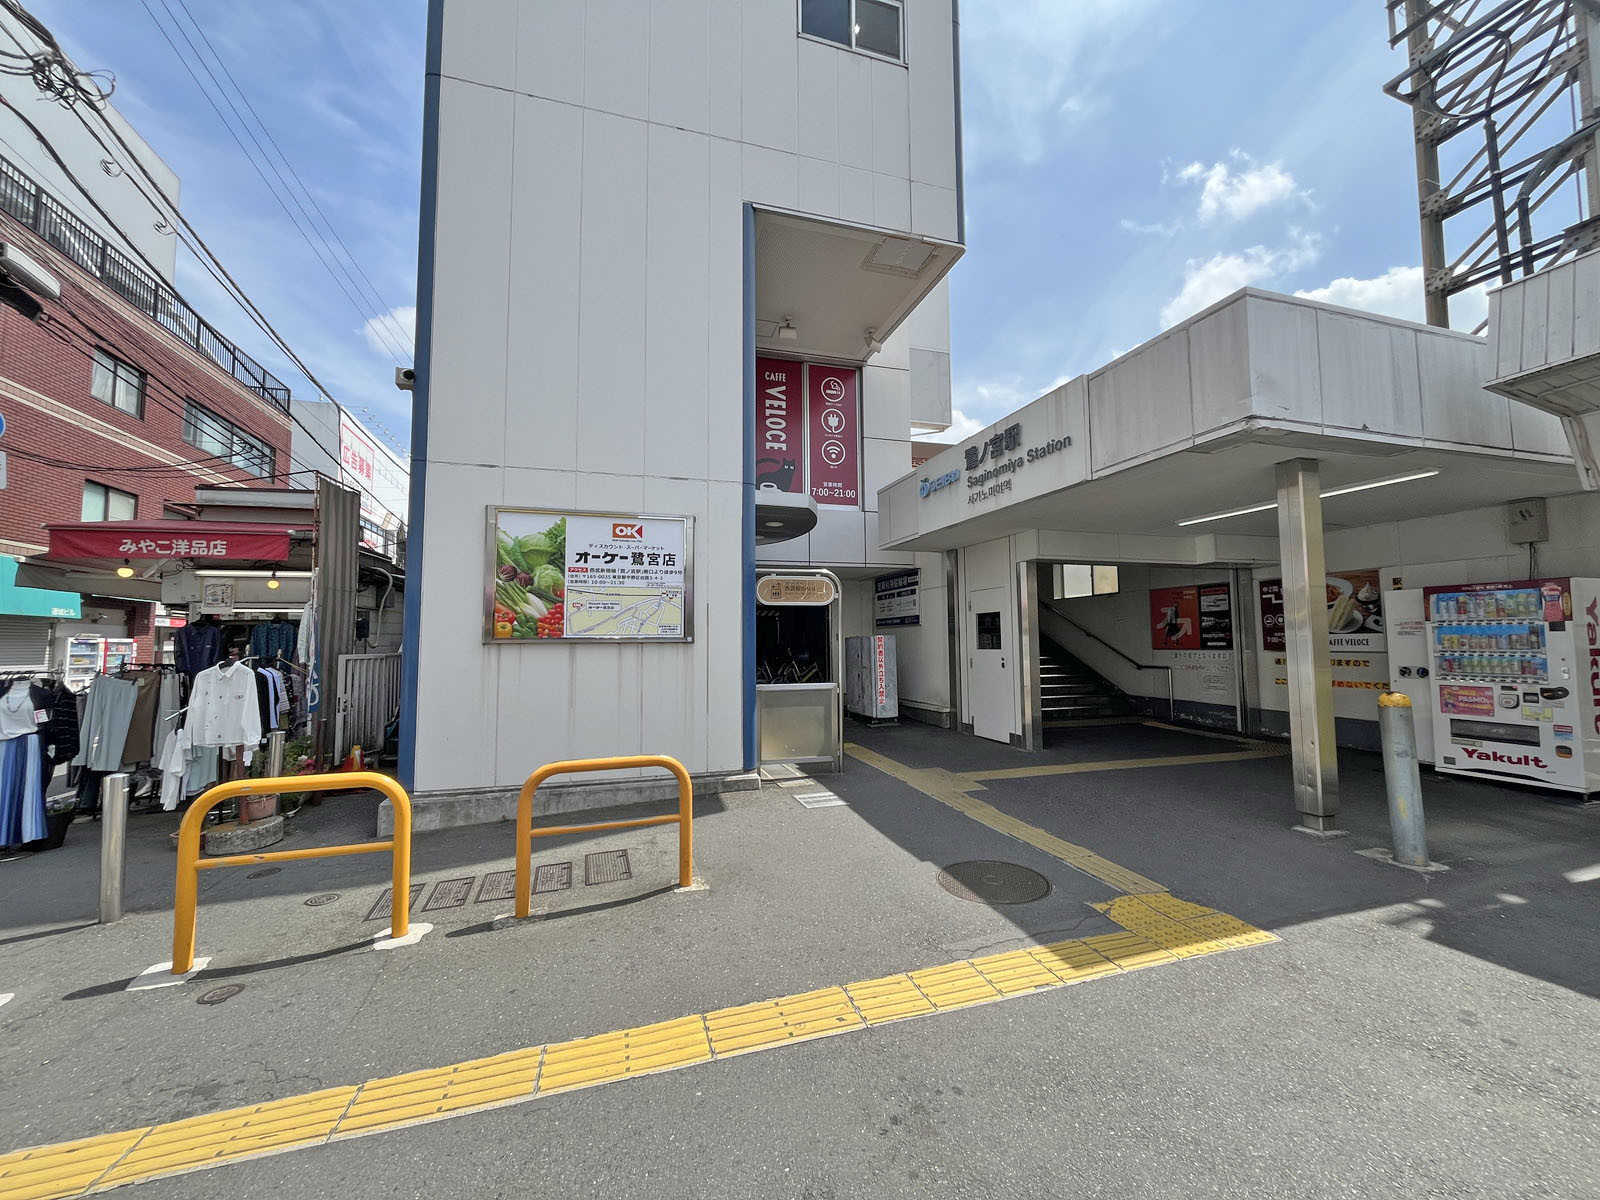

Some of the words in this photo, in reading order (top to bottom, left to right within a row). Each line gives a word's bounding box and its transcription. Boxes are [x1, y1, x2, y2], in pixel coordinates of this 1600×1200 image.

[765, 371, 786, 382] CAFFE
[765, 386, 787, 451] VELOCE
[342, 445, 372, 480] 広告募集
[967, 456, 1025, 489] Saginomiya
[1026, 435, 1073, 464] Station
[967, 478, 1013, 505] 사기노미야역
[615, 523, 642, 539] OK
[118, 539, 228, 556] みやこ洋品店
[575, 552, 676, 566] オーケー鷺宮店
[1345, 638, 1370, 646] VELOCE
[1461, 747, 1548, 769] Yakult
